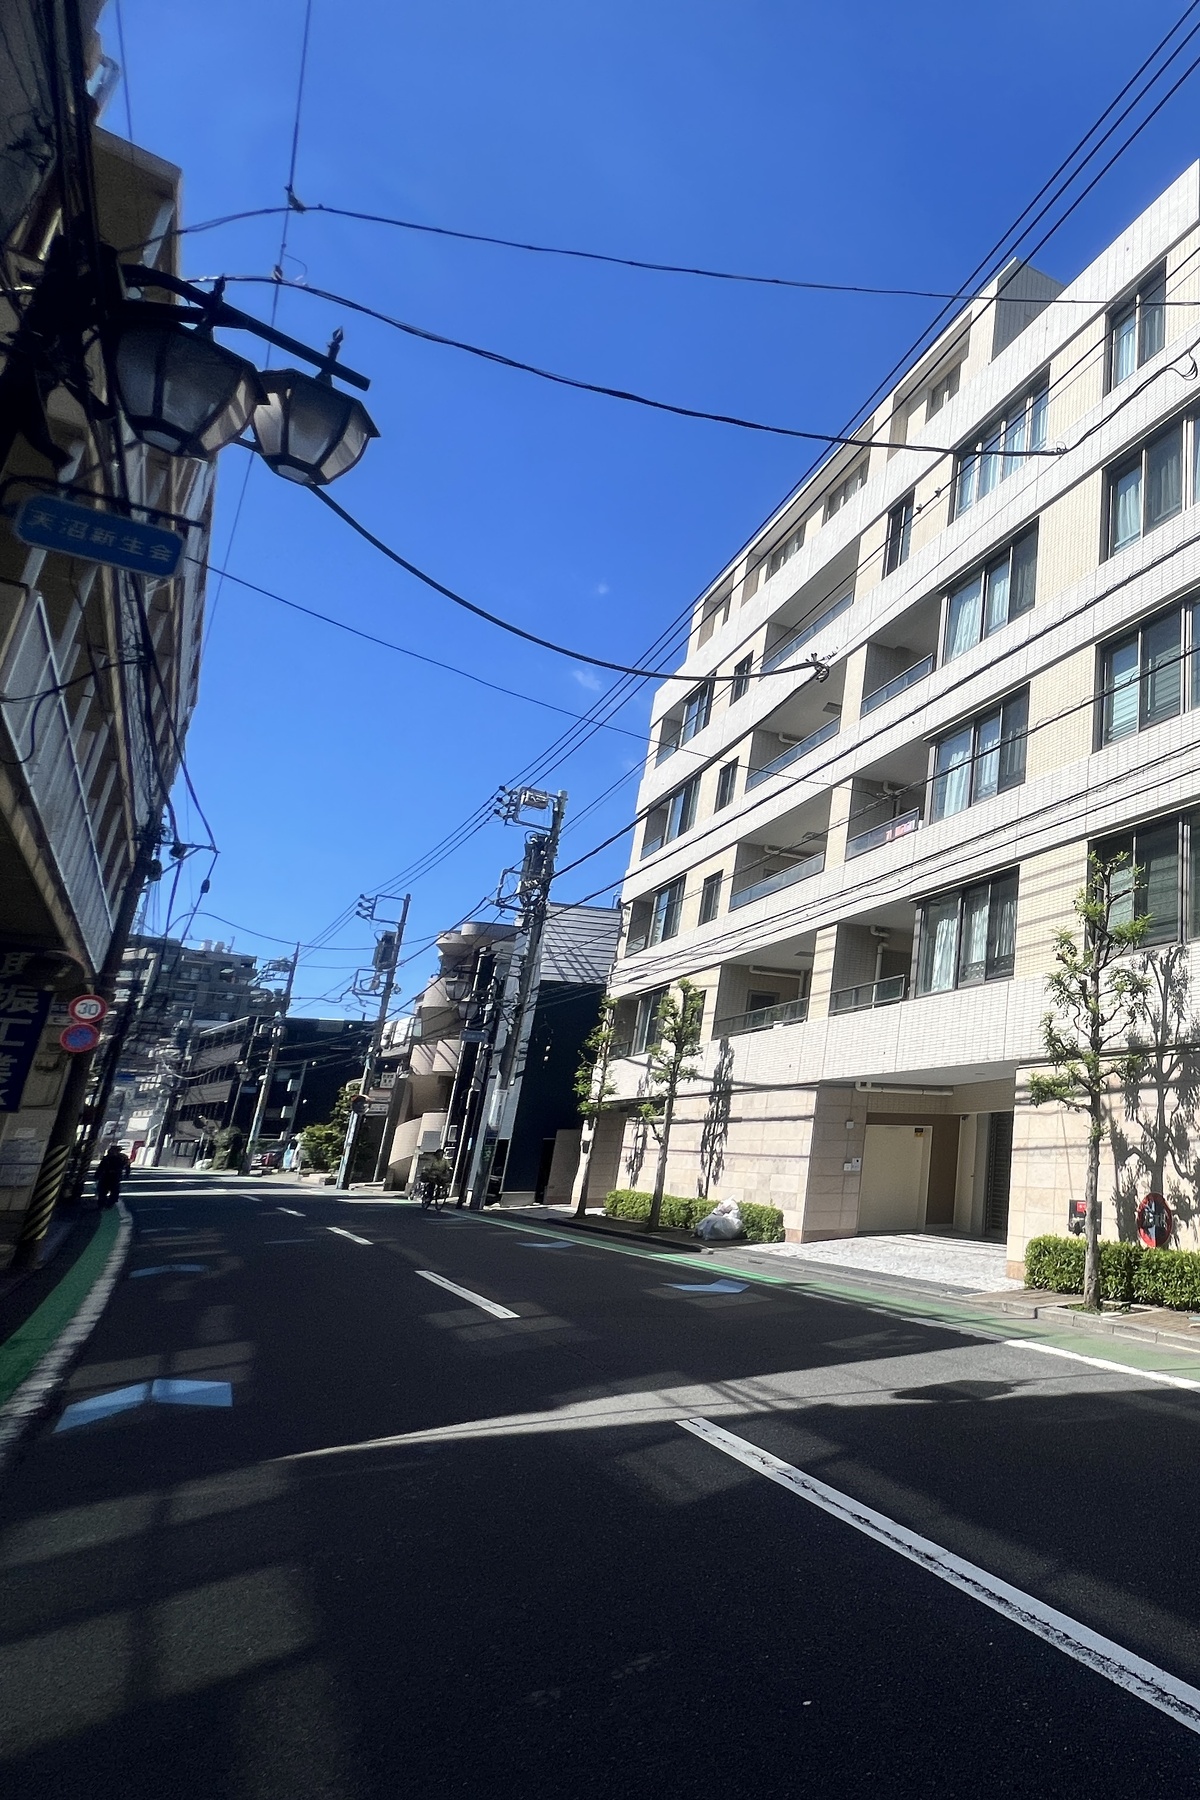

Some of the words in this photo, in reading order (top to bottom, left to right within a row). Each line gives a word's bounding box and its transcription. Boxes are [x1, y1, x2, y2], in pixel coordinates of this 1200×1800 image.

[26, 508, 173, 562] 天沼新生会
[77, 1002, 99, 1016] 30
